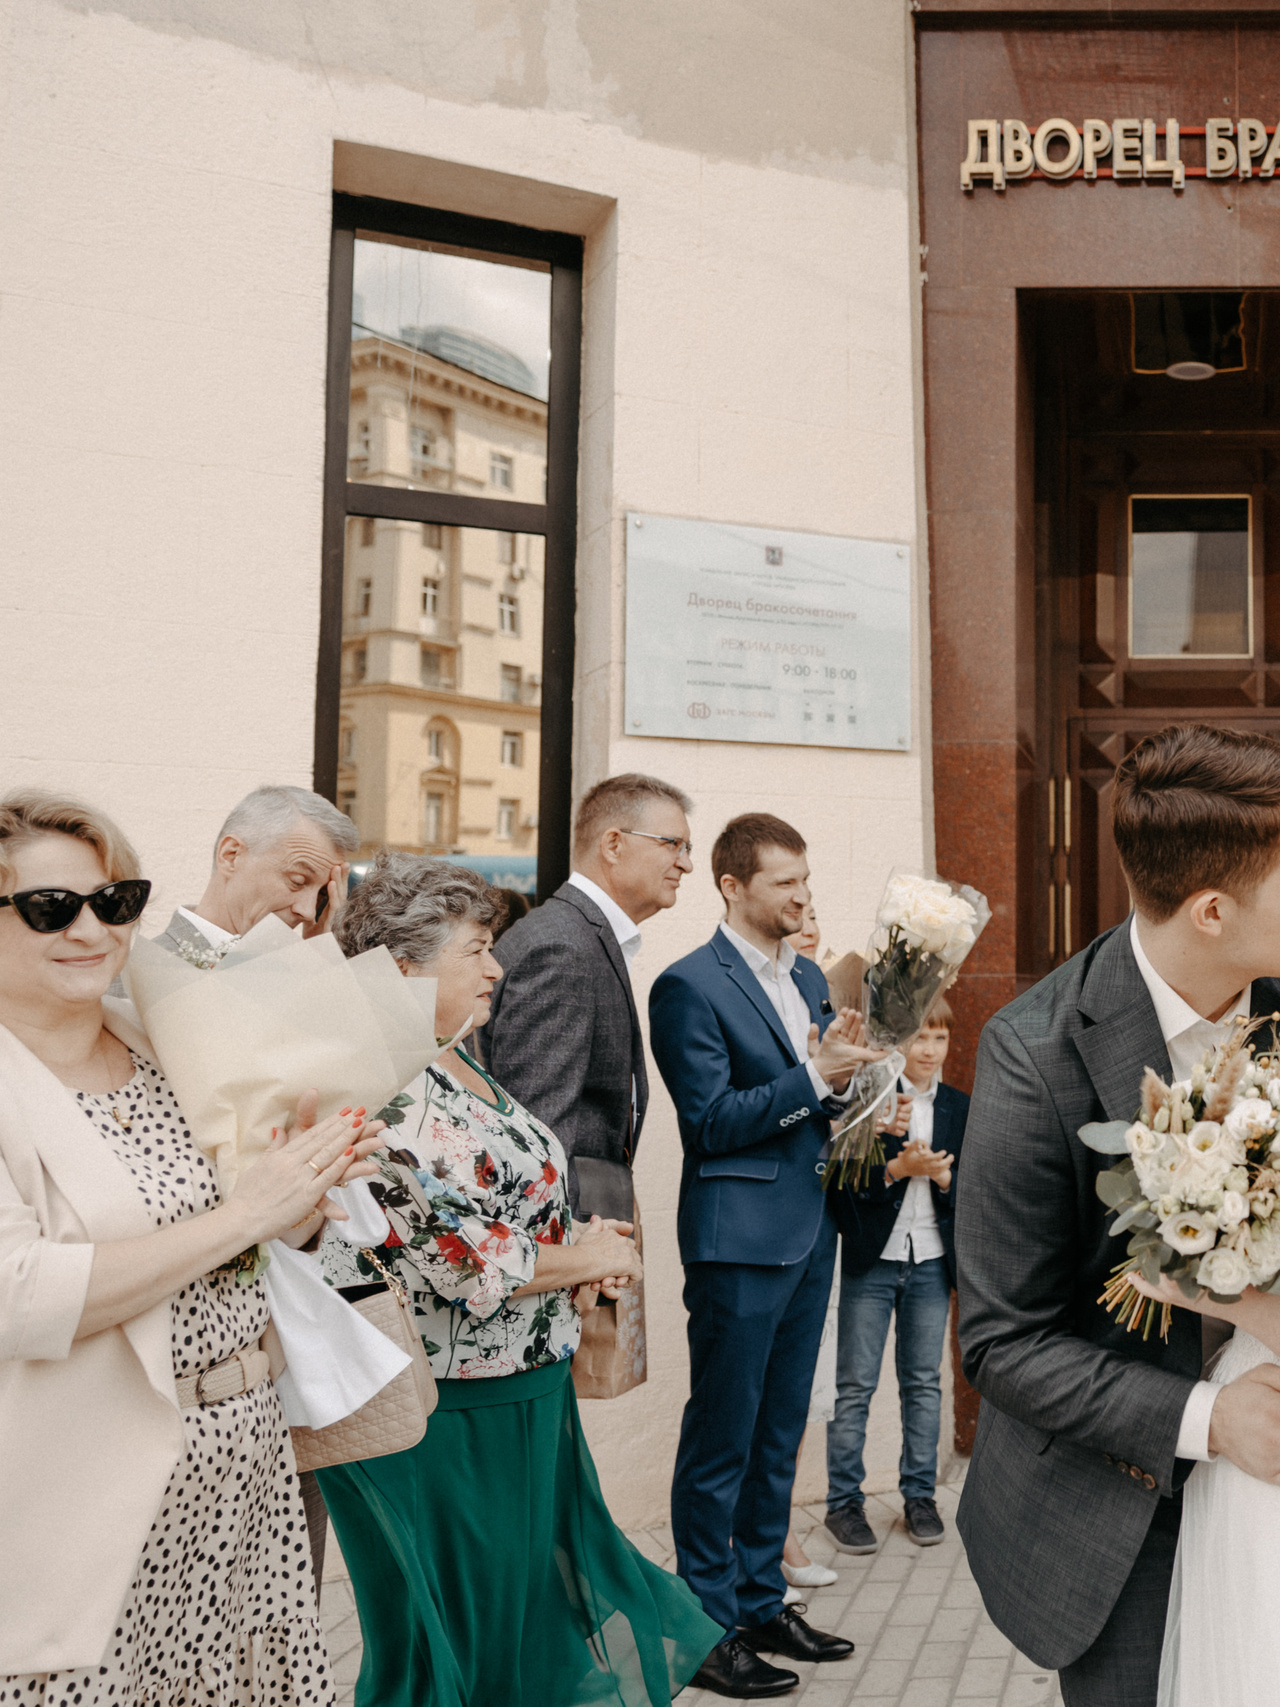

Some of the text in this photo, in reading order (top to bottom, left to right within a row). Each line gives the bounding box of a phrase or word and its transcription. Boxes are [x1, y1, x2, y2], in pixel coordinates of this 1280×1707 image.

[961, 118, 1184, 190] ДВОРЕЦ
[687, 592, 742, 611] Дворец
[745, 598, 857, 620] бракосочетания
[721, 638, 826, 657] РЕЖИМ РАБОТЫ
